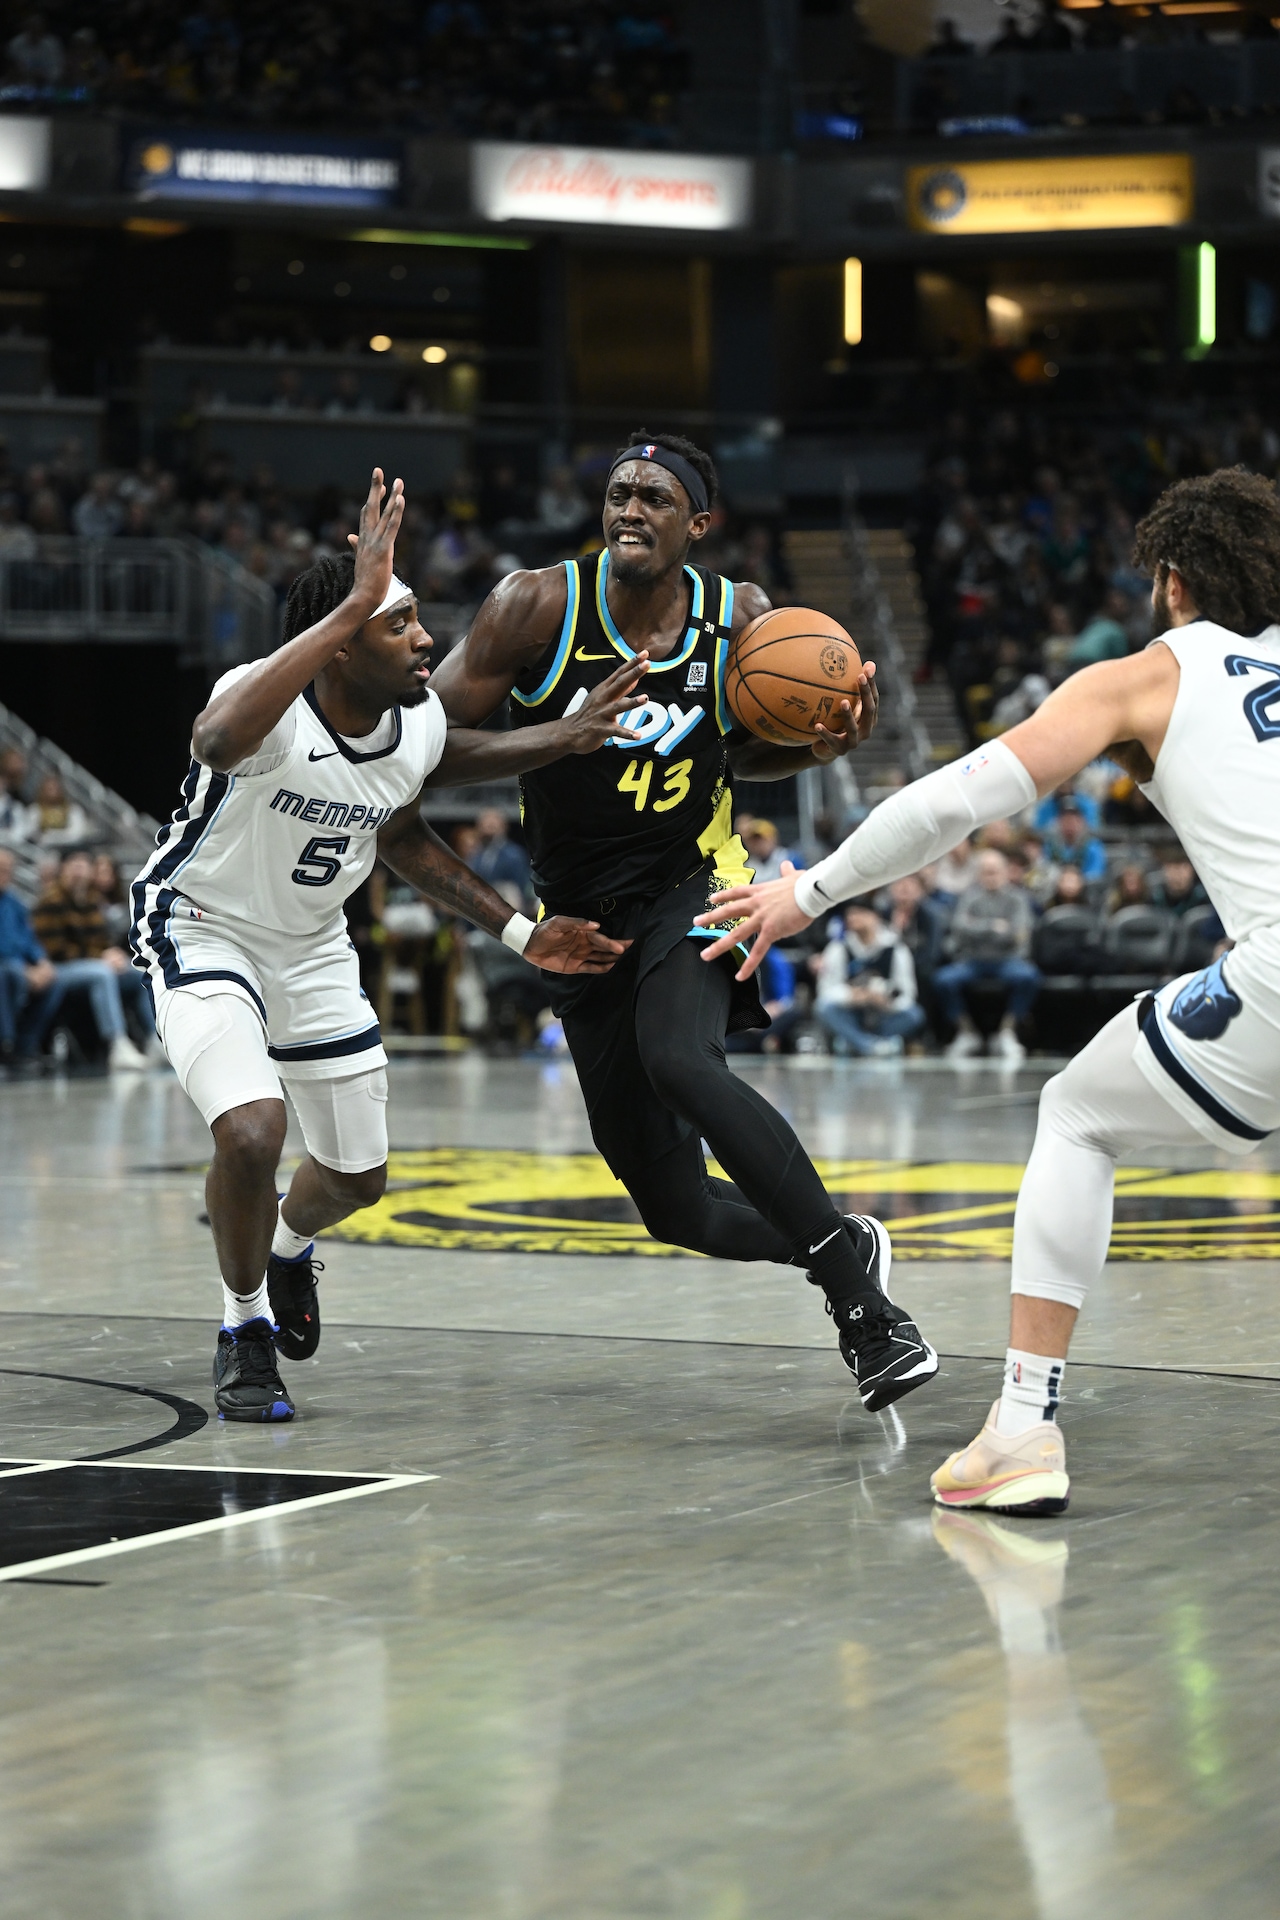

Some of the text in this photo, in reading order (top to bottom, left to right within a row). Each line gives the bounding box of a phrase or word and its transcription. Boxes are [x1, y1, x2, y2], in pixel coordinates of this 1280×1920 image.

[704, 621, 716, 635] 30
[562, 687, 706, 757] DY
[1224, 654, 1280, 743] 2
[269, 788, 399, 830] MEMPHI
[617, 758, 694, 812] 43
[291, 836, 351, 887] 5
